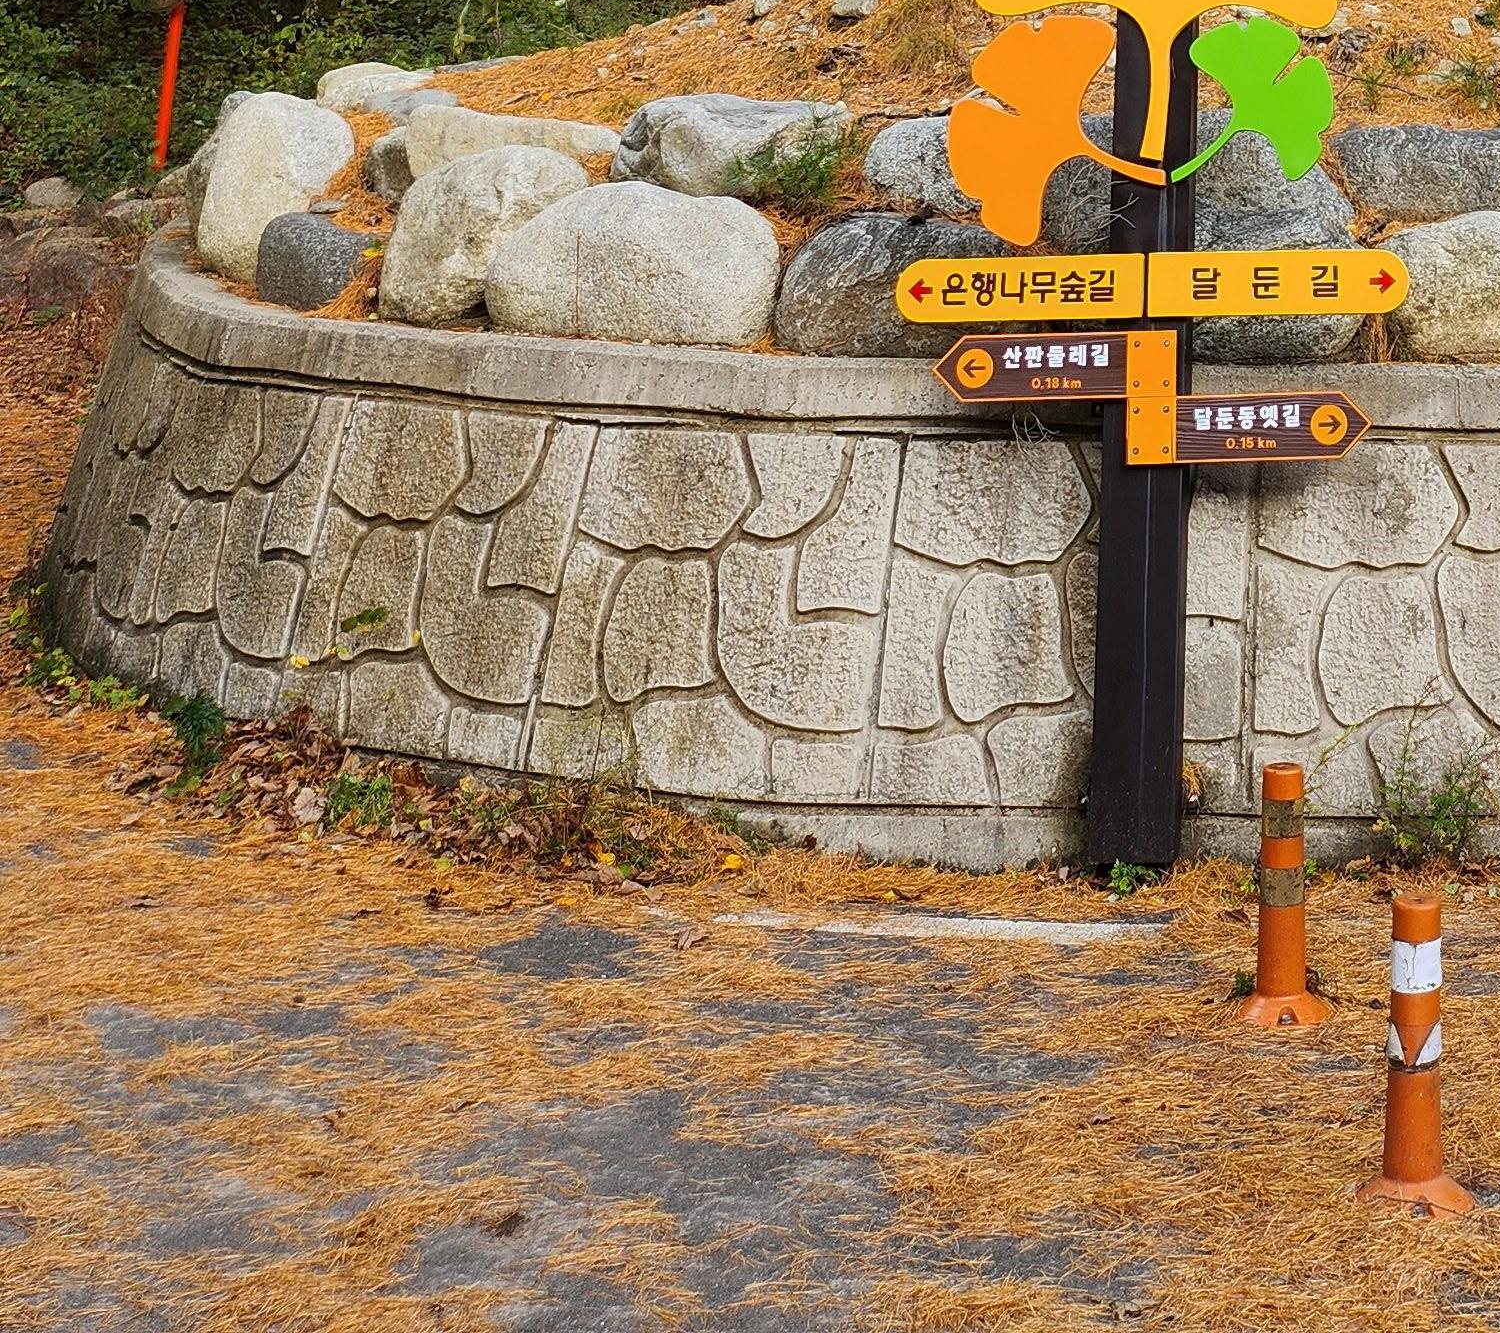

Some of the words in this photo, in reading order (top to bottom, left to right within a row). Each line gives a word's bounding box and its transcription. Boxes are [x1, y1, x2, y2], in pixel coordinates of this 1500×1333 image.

[941, 269, 1115, 306] 은행나무숲길
[1002, 343, 1109, 369] 산판둘레길
[1031, 377, 1059, 390] 0.18
[1062, 376, 1082, 389] km
[1194, 404, 1300, 430] 달둔동옛길
[1225, 437, 1254, 450] 0.15
[1257, 436, 1277, 449] km
